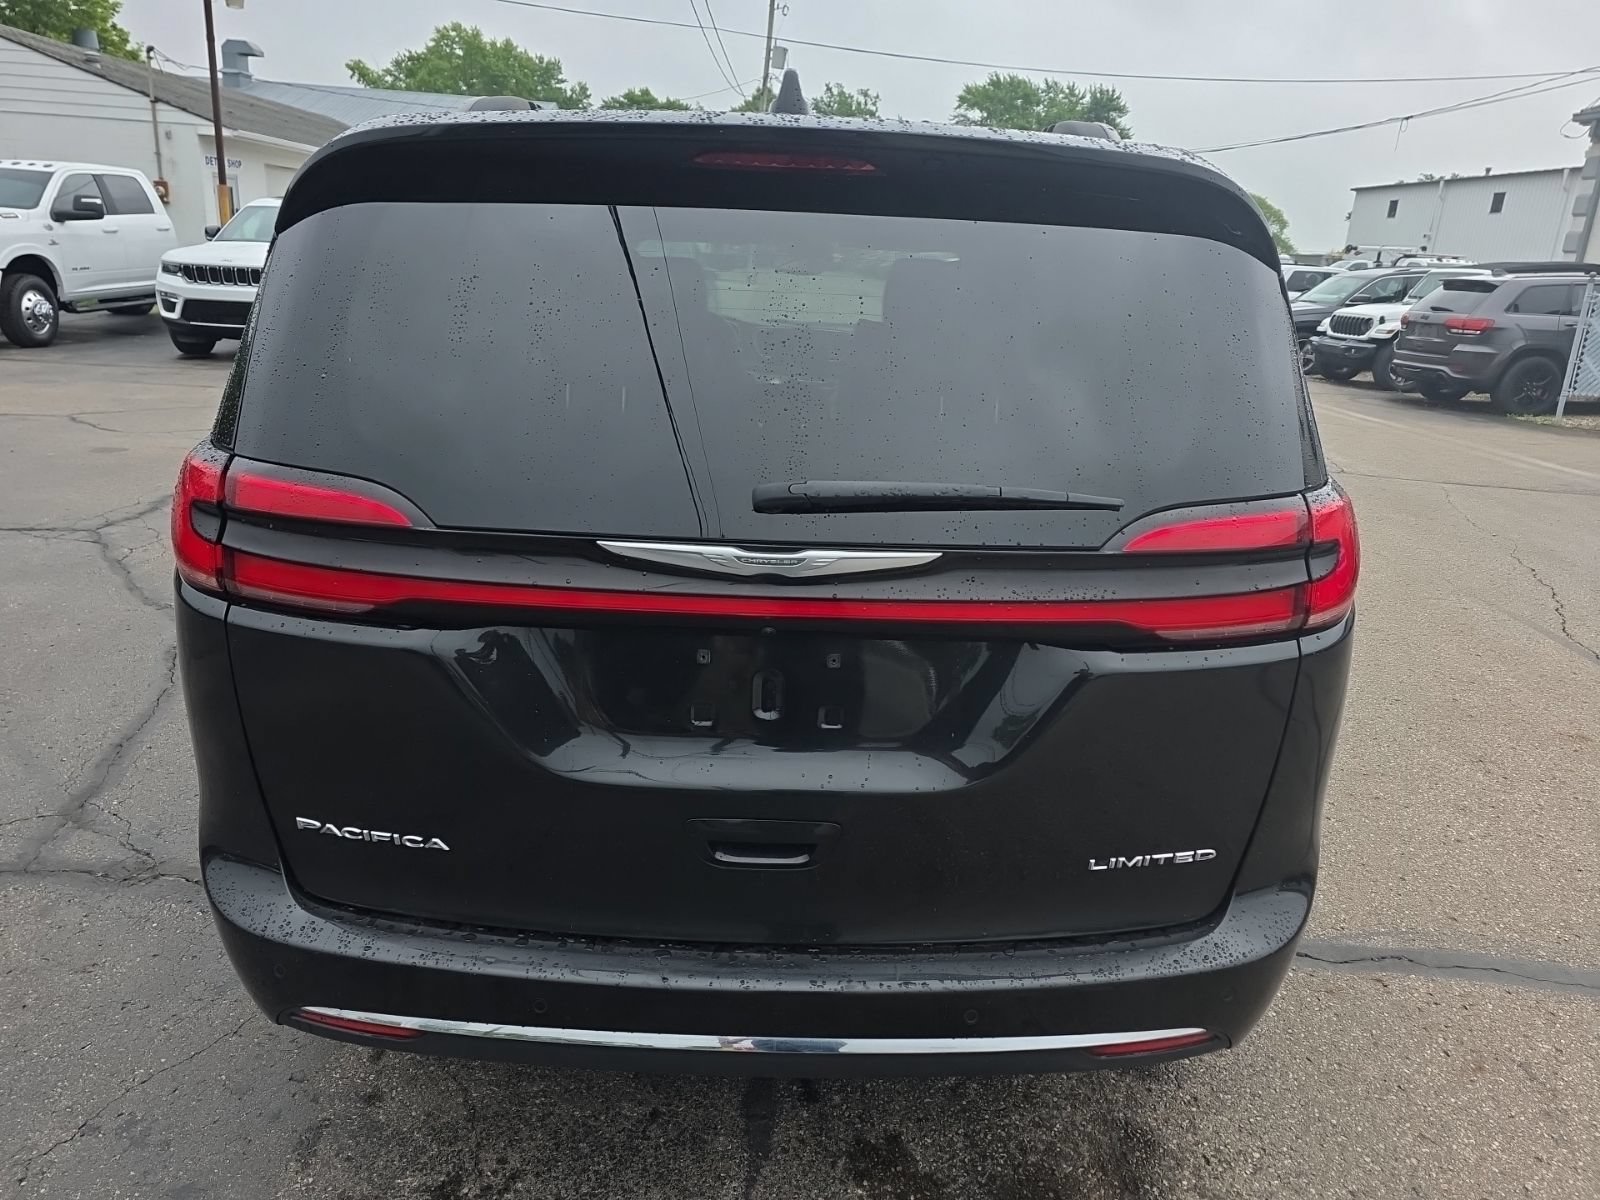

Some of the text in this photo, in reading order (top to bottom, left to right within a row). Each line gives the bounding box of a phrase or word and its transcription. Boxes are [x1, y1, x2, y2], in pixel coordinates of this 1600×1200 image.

[204, 156, 219, 167] DET
[295, 816, 450, 851] PACIFICA
[1088, 848, 1217, 871] LIMITED
